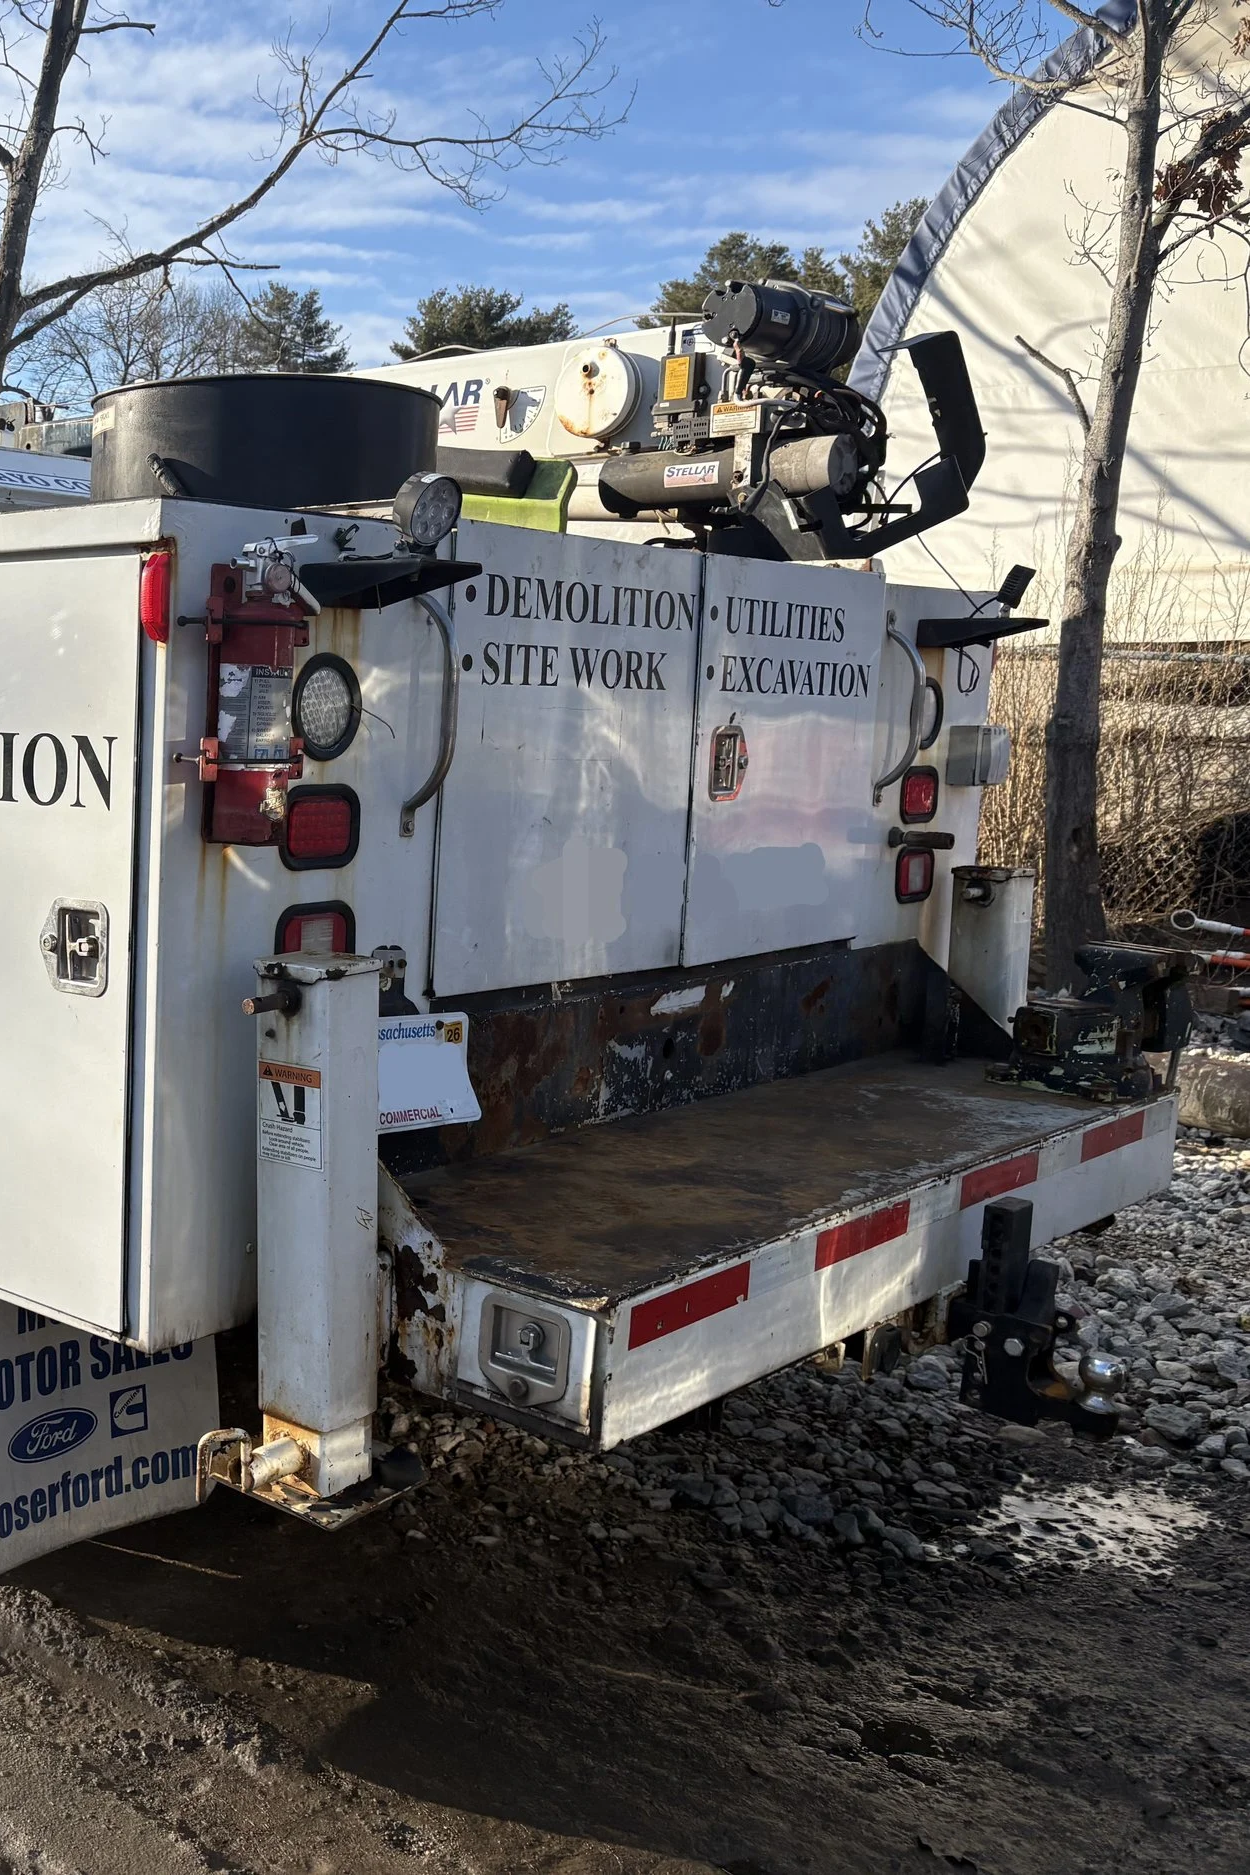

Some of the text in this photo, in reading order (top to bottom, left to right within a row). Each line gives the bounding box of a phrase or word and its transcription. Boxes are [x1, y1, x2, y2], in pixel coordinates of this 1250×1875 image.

[666, 465, 716, 478] STELLAR
[484, 573, 697, 632] DEMOLITION
[726, 596, 846, 643] UTILITIES
[481, 641, 668, 691] SITE WORK
[719, 655, 872, 698] EXCAVATION
[446, 1028, 460, 1043] 26
[274, 1069, 313, 1083] WARNING
[277, 1125, 293, 1133] Hazard
[379, 1106, 443, 1125] COMMERCIAL
[113, 1388, 141, 1419] Cummins
[26, 1416, 78, 1455] Ford
